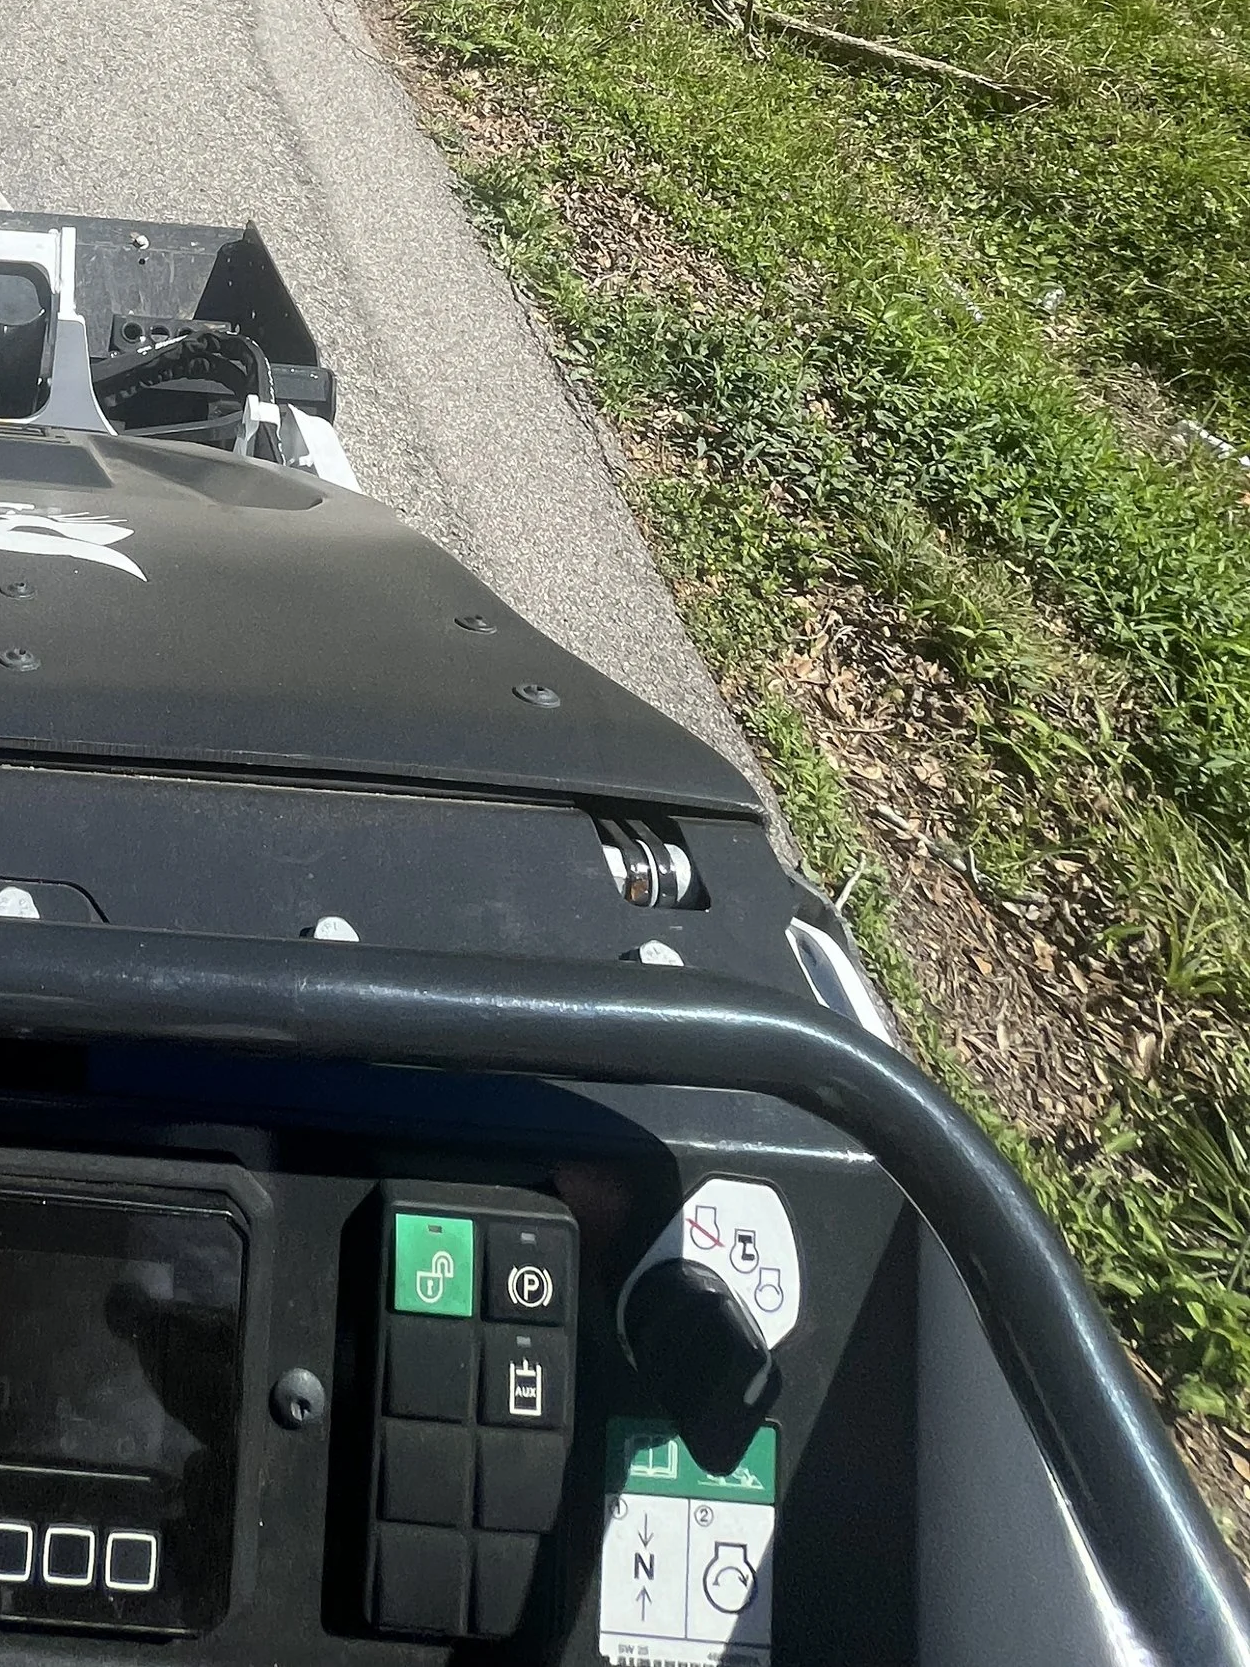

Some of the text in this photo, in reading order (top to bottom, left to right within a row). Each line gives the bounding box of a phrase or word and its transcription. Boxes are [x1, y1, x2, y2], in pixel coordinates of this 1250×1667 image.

[523, 1273, 540, 1301] P
[515, 1386, 537, 1398] AUX
[633, 1552, 655, 1581] N
